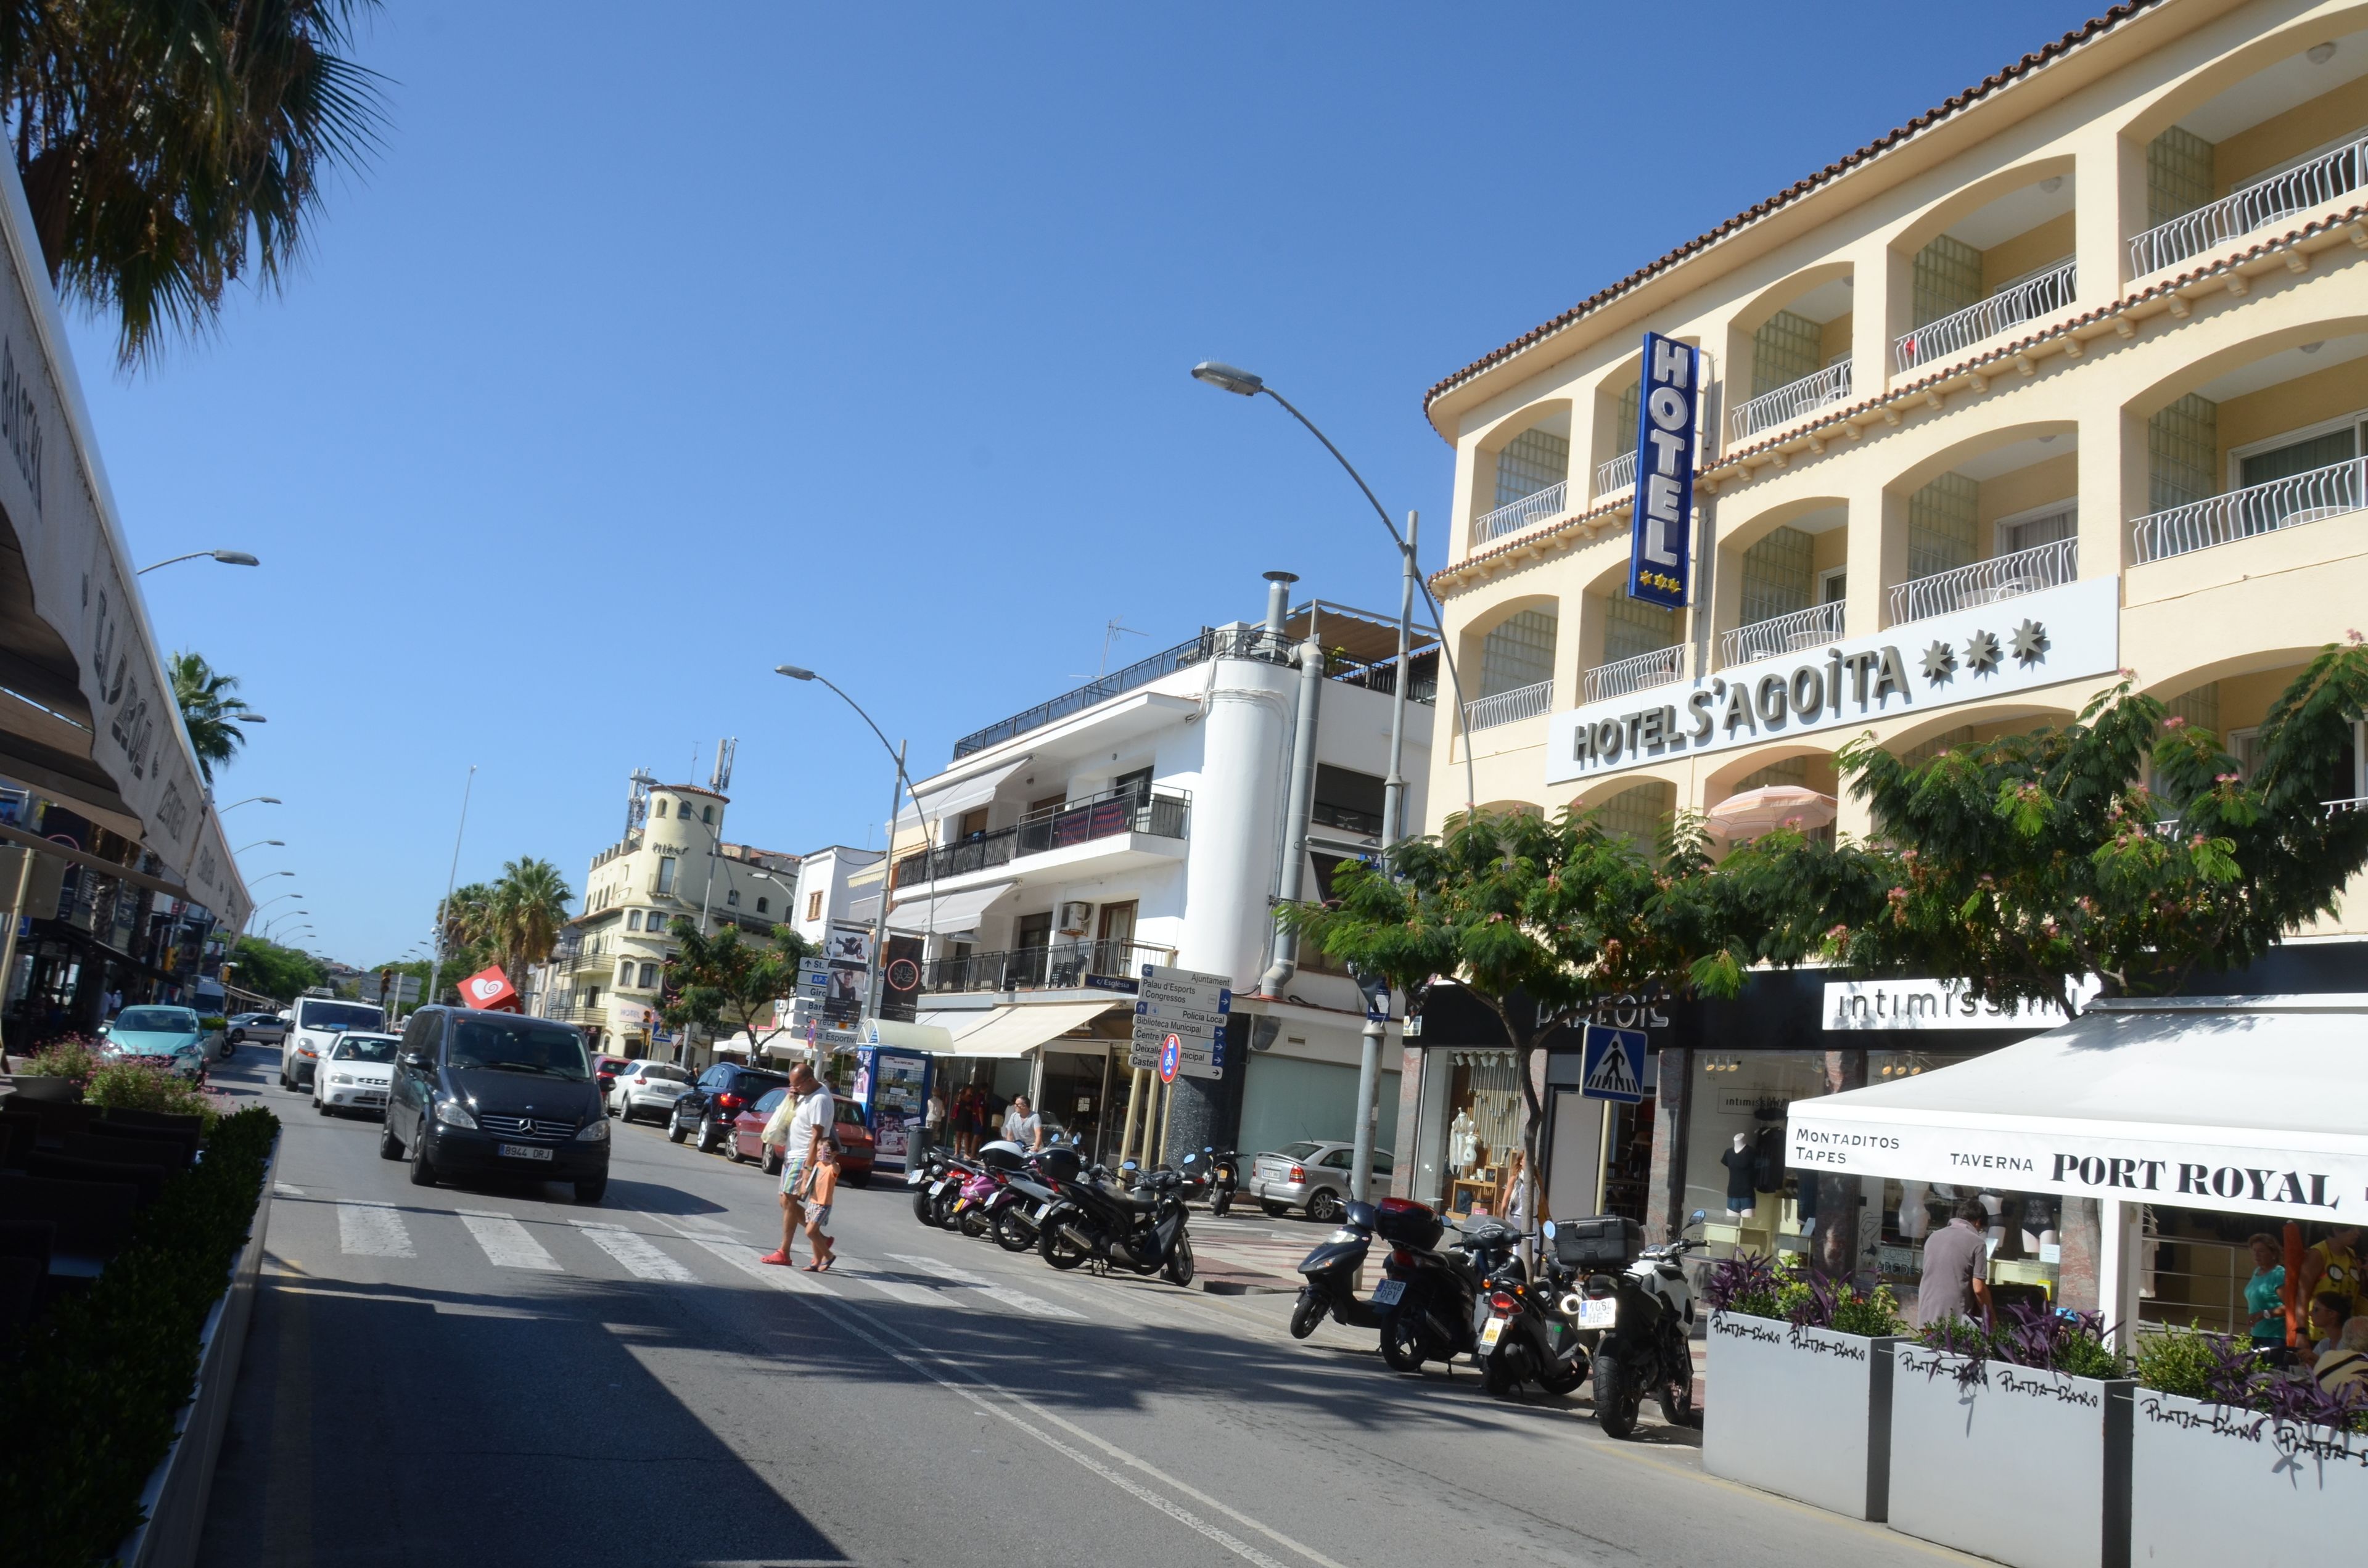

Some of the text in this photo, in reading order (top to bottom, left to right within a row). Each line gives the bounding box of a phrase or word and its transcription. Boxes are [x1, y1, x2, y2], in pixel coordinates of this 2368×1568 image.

[1645, 339, 1688, 567] HOTEL
[1573, 705, 1687, 763] HOTEL
[813, 961, 824, 969] St.
[894, 972, 913, 983] JAZZ
[1096, 979, 1103, 987] c/
[1191, 973, 1230, 987] Ajuntament
[1143, 979, 1196, 995] Palau d'Esports
[1145, 989, 1186, 1004] Congressos
[806, 1016, 836, 1027] Crreus
[1182, 1010, 1225, 1024] Policia Local
[1137, 1017, 1202, 1033] Biblioteca Municipal
[804, 1029, 823, 1040] Zna
[1136, 1030, 1160, 1041] Centre
[1132, 1056, 1159, 1068] Castell
[1796, 1128, 1900, 1150] MONTADITOS
[504, 1146, 551, 1159] 8944 DRJ
[1795, 1147, 1847, 1164] TAPES
[1950, 1152, 2341, 1211] TAVERNA PORT ROYAL
[1384, 1281, 1403, 1292] 3346
[1381, 1289, 1398, 1300] DPV
